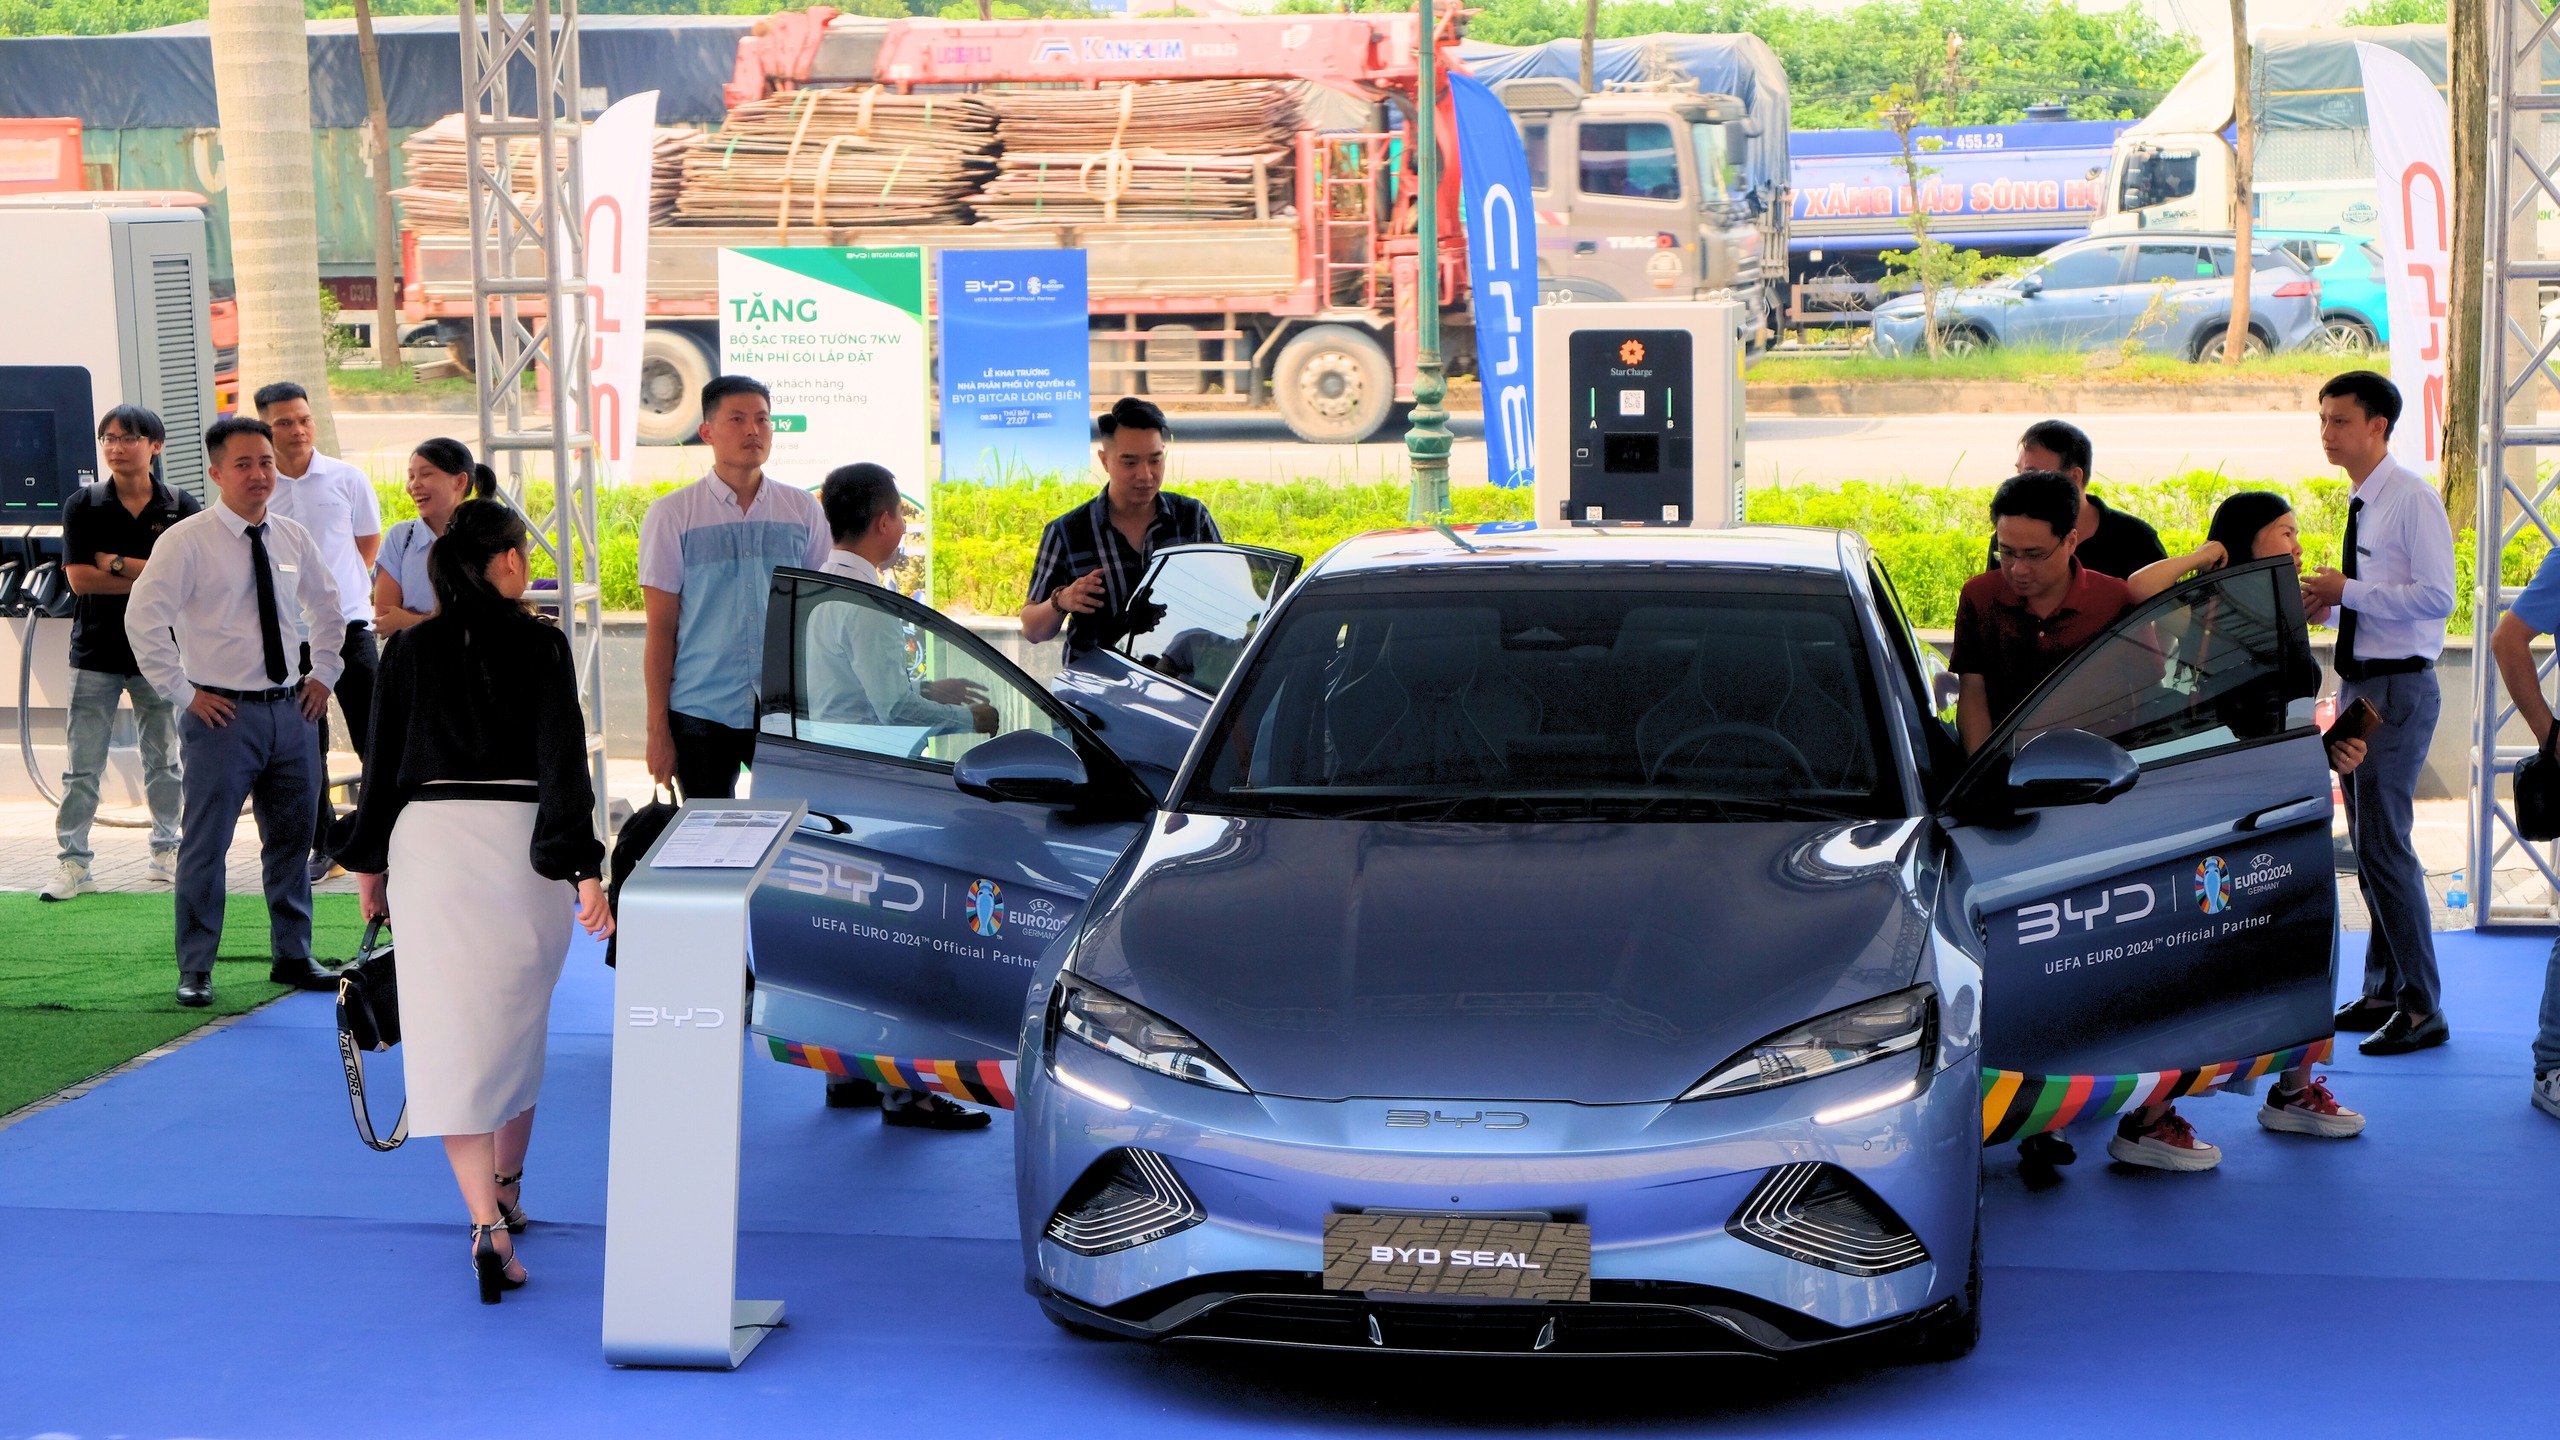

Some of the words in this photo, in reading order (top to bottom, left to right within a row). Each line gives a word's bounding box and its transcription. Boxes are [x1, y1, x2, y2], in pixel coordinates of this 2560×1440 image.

[1957, 133, 2003, 149] 455.23
[1804, 182, 1892, 217] XĂNG
[1970, 177, 2058, 211] SÔNG
[965, 280, 1015, 293] BYD
[729, 292, 818, 330] TẶNG
[730, 332, 748, 347] BỘ
[752, 335, 777, 347] SẠC
[781, 335, 816, 344] TREO
[820, 332, 867, 344] TƯỜNG
[870, 334, 901, 344] 7KW
[730, 348, 763, 362] MIỄN
[768, 350, 789, 362] PHÍ
[820, 348, 844, 362] LẮP
[848, 350, 873, 365] ĐẶT
[983, 368, 993, 377] LỄ
[995, 369, 1014, 377] KHAI
[777, 379, 811, 388] khách
[815, 379, 844, 390] hàng
[958, 381, 976, 390] NHÀ
[977, 381, 1000, 389] PHÂN
[1002, 379, 1022, 389] PHỐI
[799, 395, 829, 404] trong
[834, 394, 868, 404] tháng
[952, 394, 975, 403] BYD
[978, 393, 1018, 402] BITCAR
[1021, 391, 1052, 401] LONG
[1055, 390, 1081, 400] BIÊN
[778, 419, 792, 431] ký
[1006, 416, 1027, 424] 27.07
[1589, 419, 1598, 429] A
[1667, 419, 1674, 429] B
[2251, 856, 2272, 870] UEFA
[2234, 863, 2293, 890] EURO2024
[788, 856, 924, 912] BYD
[2247, 881, 2280, 895] GERMANY
[1030, 902, 1053, 914] UEFA
[2017, 883, 2155, 945] BYD
[1022, 928, 1056, 940] GERMAN
[812, 916, 847, 933] UEFA
[852, 924, 888, 940] EURO
[932, 940, 984, 959] Official
[993, 950, 1039, 968] Partne
[2045, 956, 2081, 975] UEFA
[2087, 946, 2124, 966] EURO
[2166, 926, 2214, 947] Official
[2222, 914, 2272, 935] Partner
[629, 1006, 724, 1028] BYD
[346, 1064, 361, 1097] KORS
[1385, 1109, 1529, 1129] BYD
[1371, 1246, 1441, 1265] BYD
[1450, 1250, 1541, 1269] SEAL
